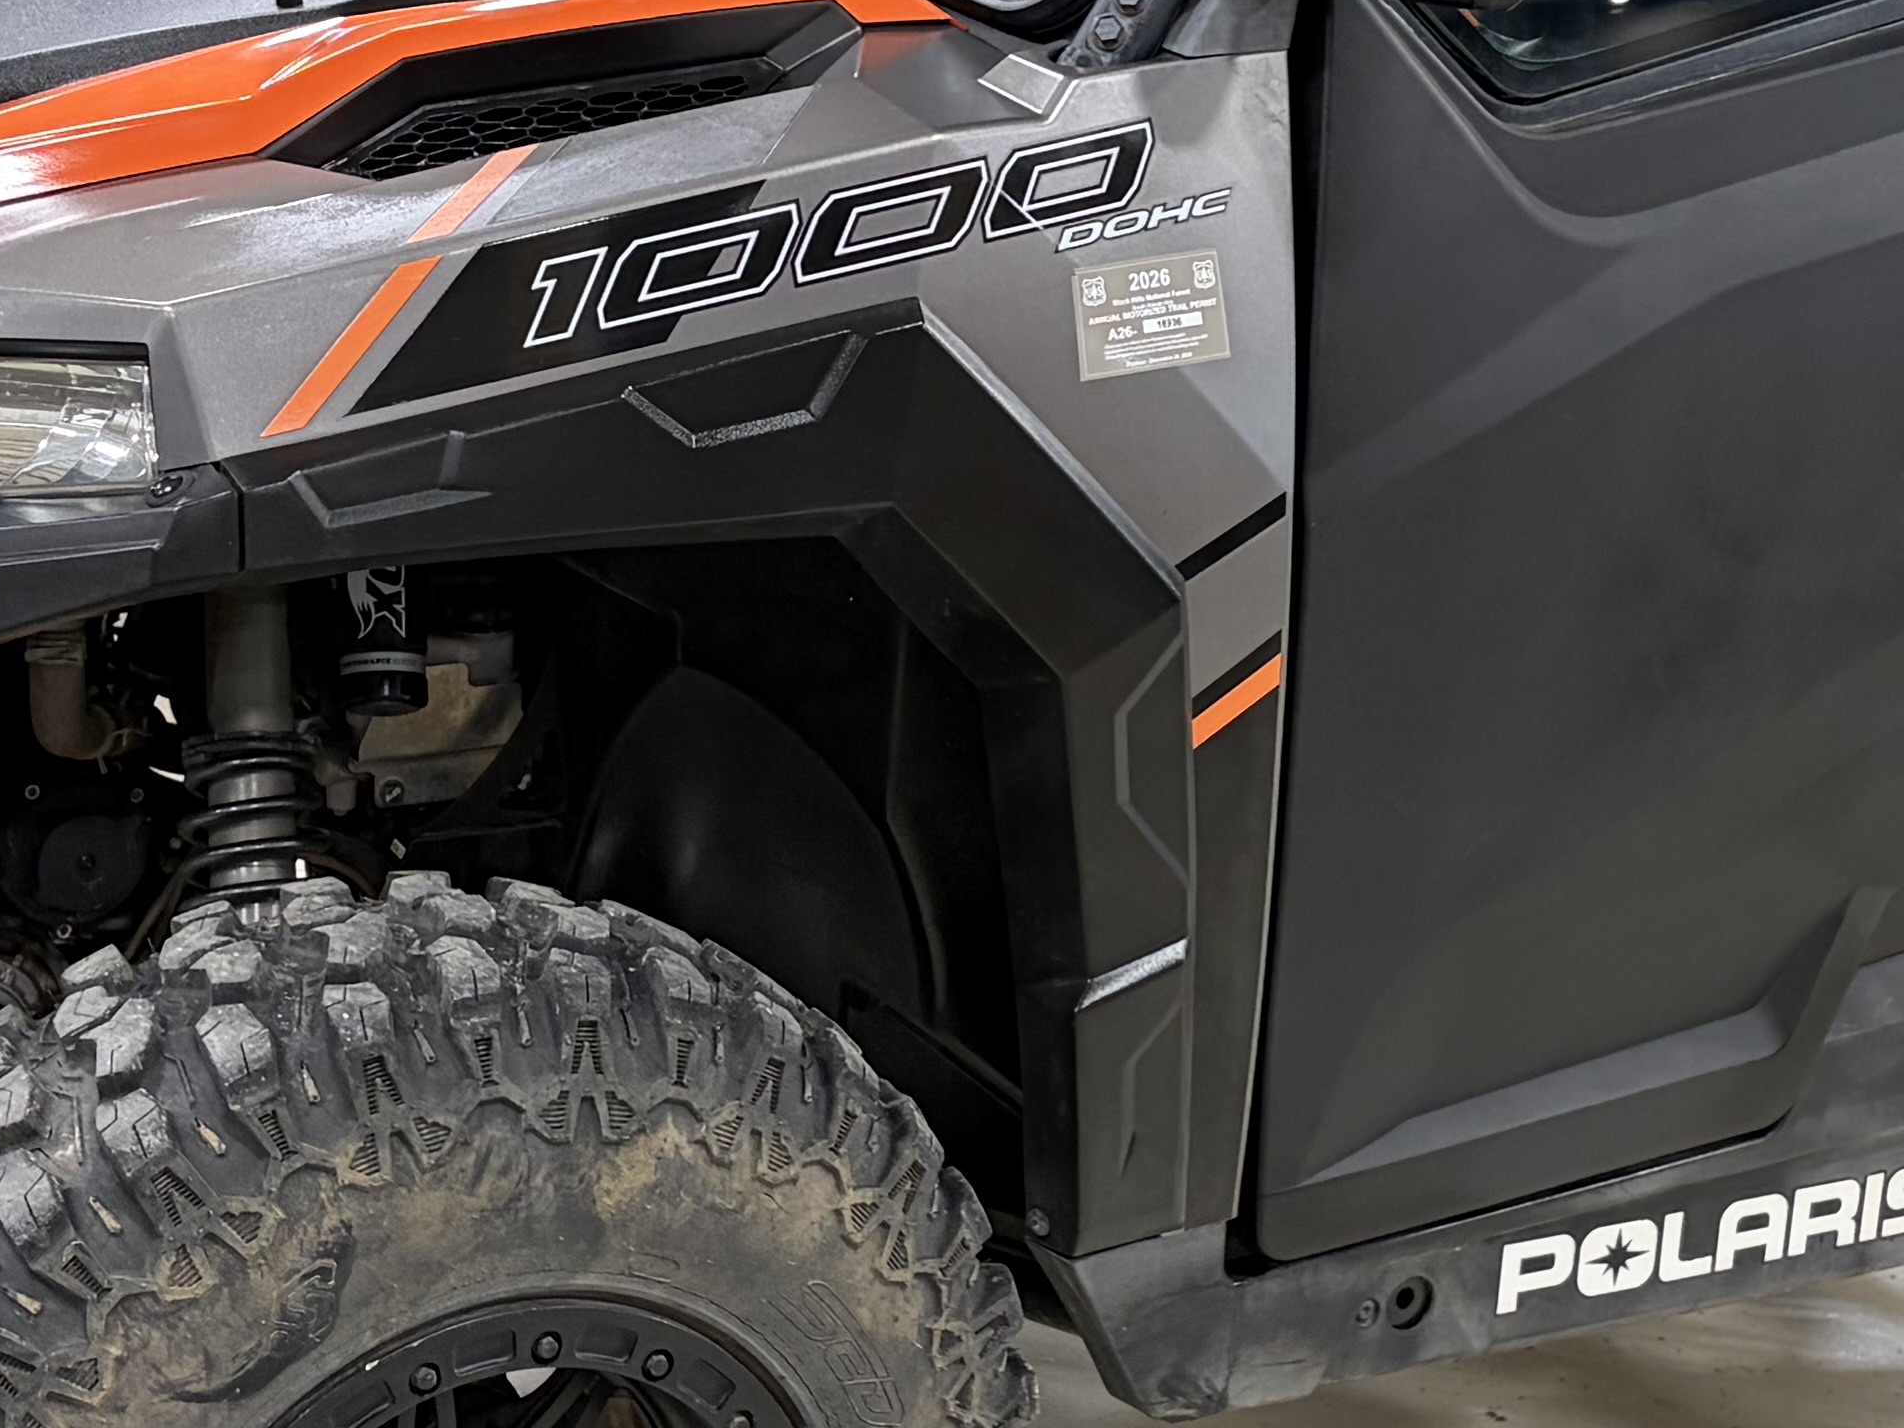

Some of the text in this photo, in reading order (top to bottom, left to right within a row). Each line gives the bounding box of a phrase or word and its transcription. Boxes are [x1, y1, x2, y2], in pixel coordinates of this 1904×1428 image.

[523, 118, 1156, 351] 1000
[1054, 186, 1233, 254] DOHC
[1128, 268, 1171, 292] 2026
